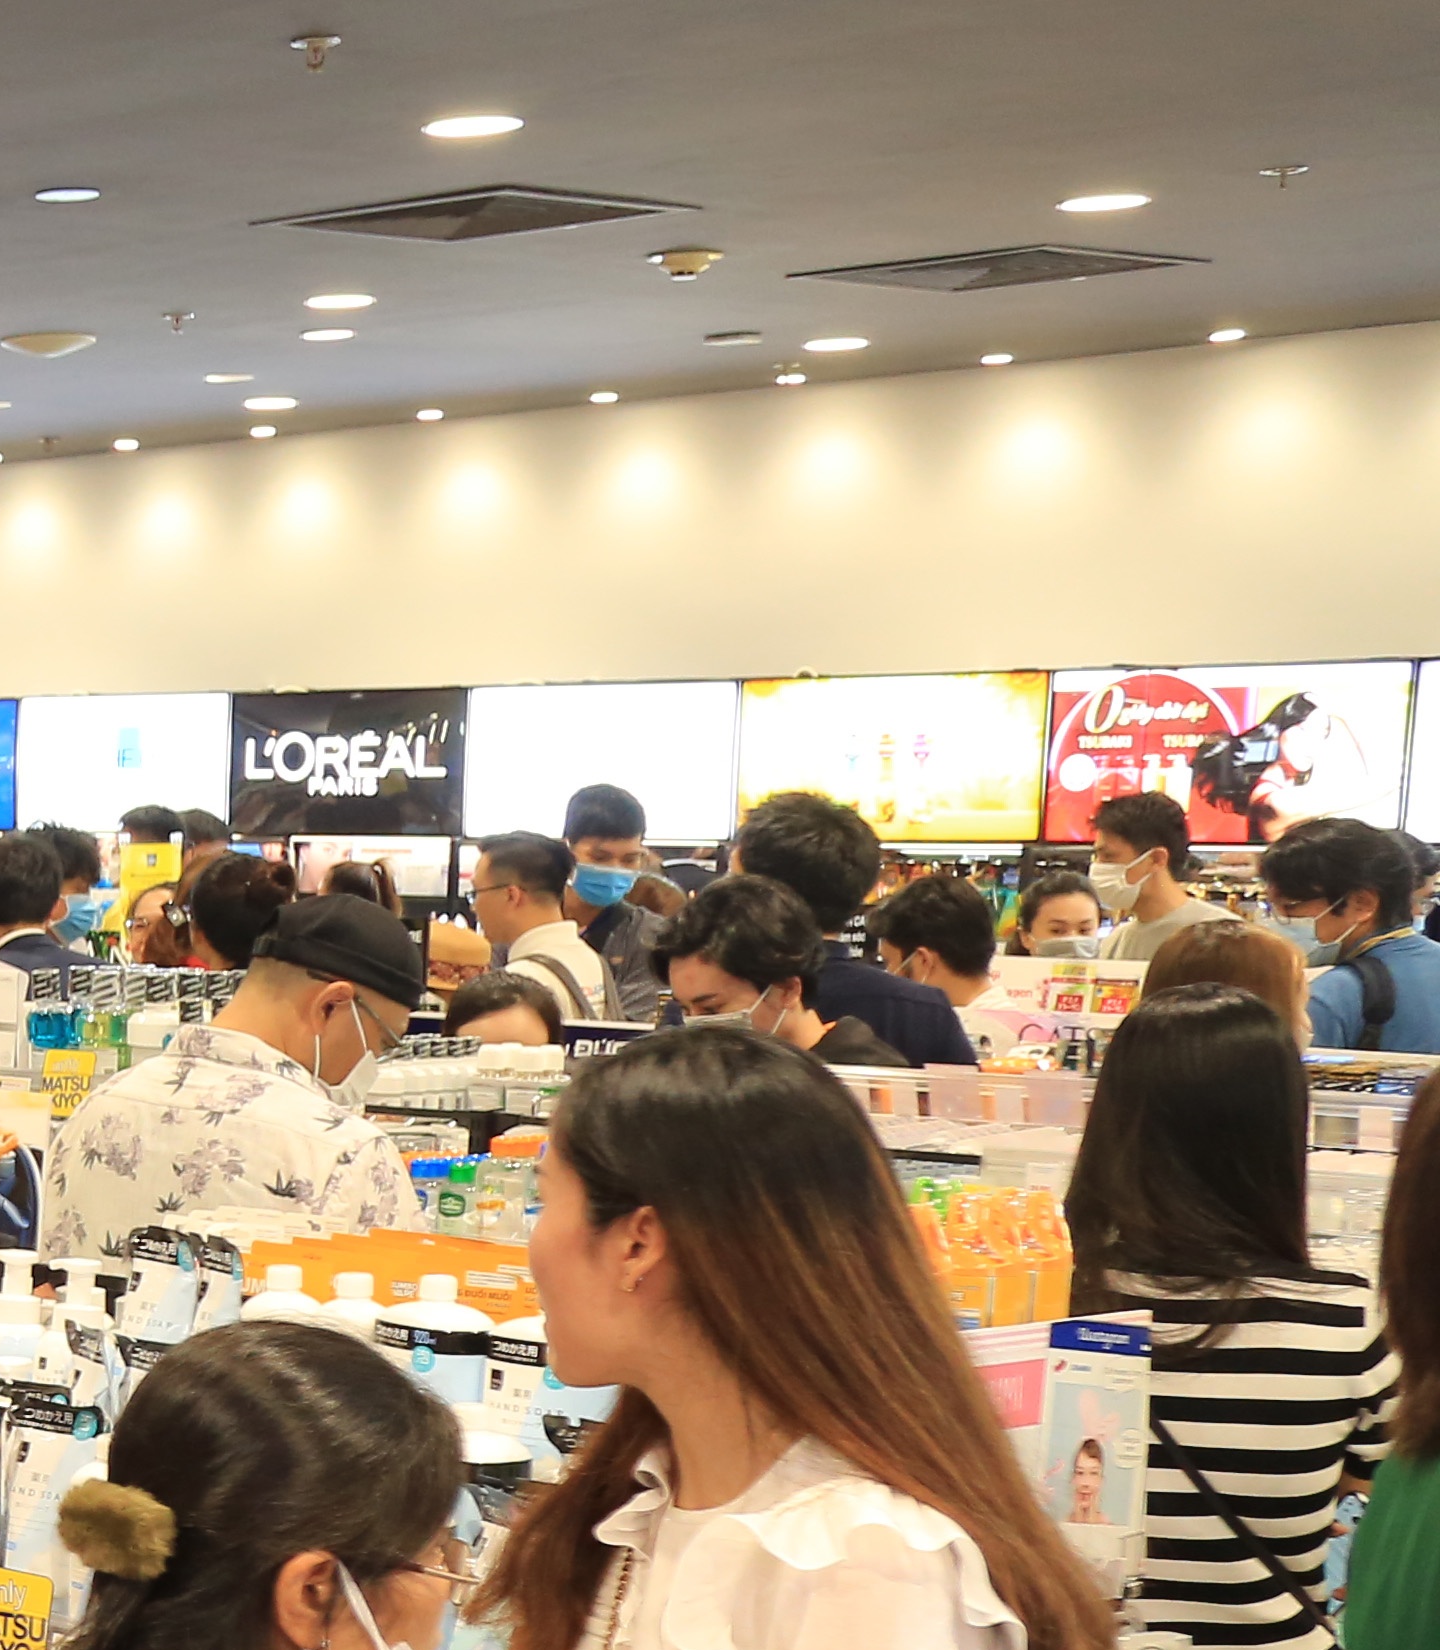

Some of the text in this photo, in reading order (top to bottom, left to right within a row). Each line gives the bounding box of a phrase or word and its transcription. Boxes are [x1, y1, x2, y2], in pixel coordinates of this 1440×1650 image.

[1163, 735, 1205, 747] TSUBA
[244, 729, 448, 782] L'ORÉAL
[307, 777, 379, 797] PARIS
[42, 1076, 91, 1092] MATSU
